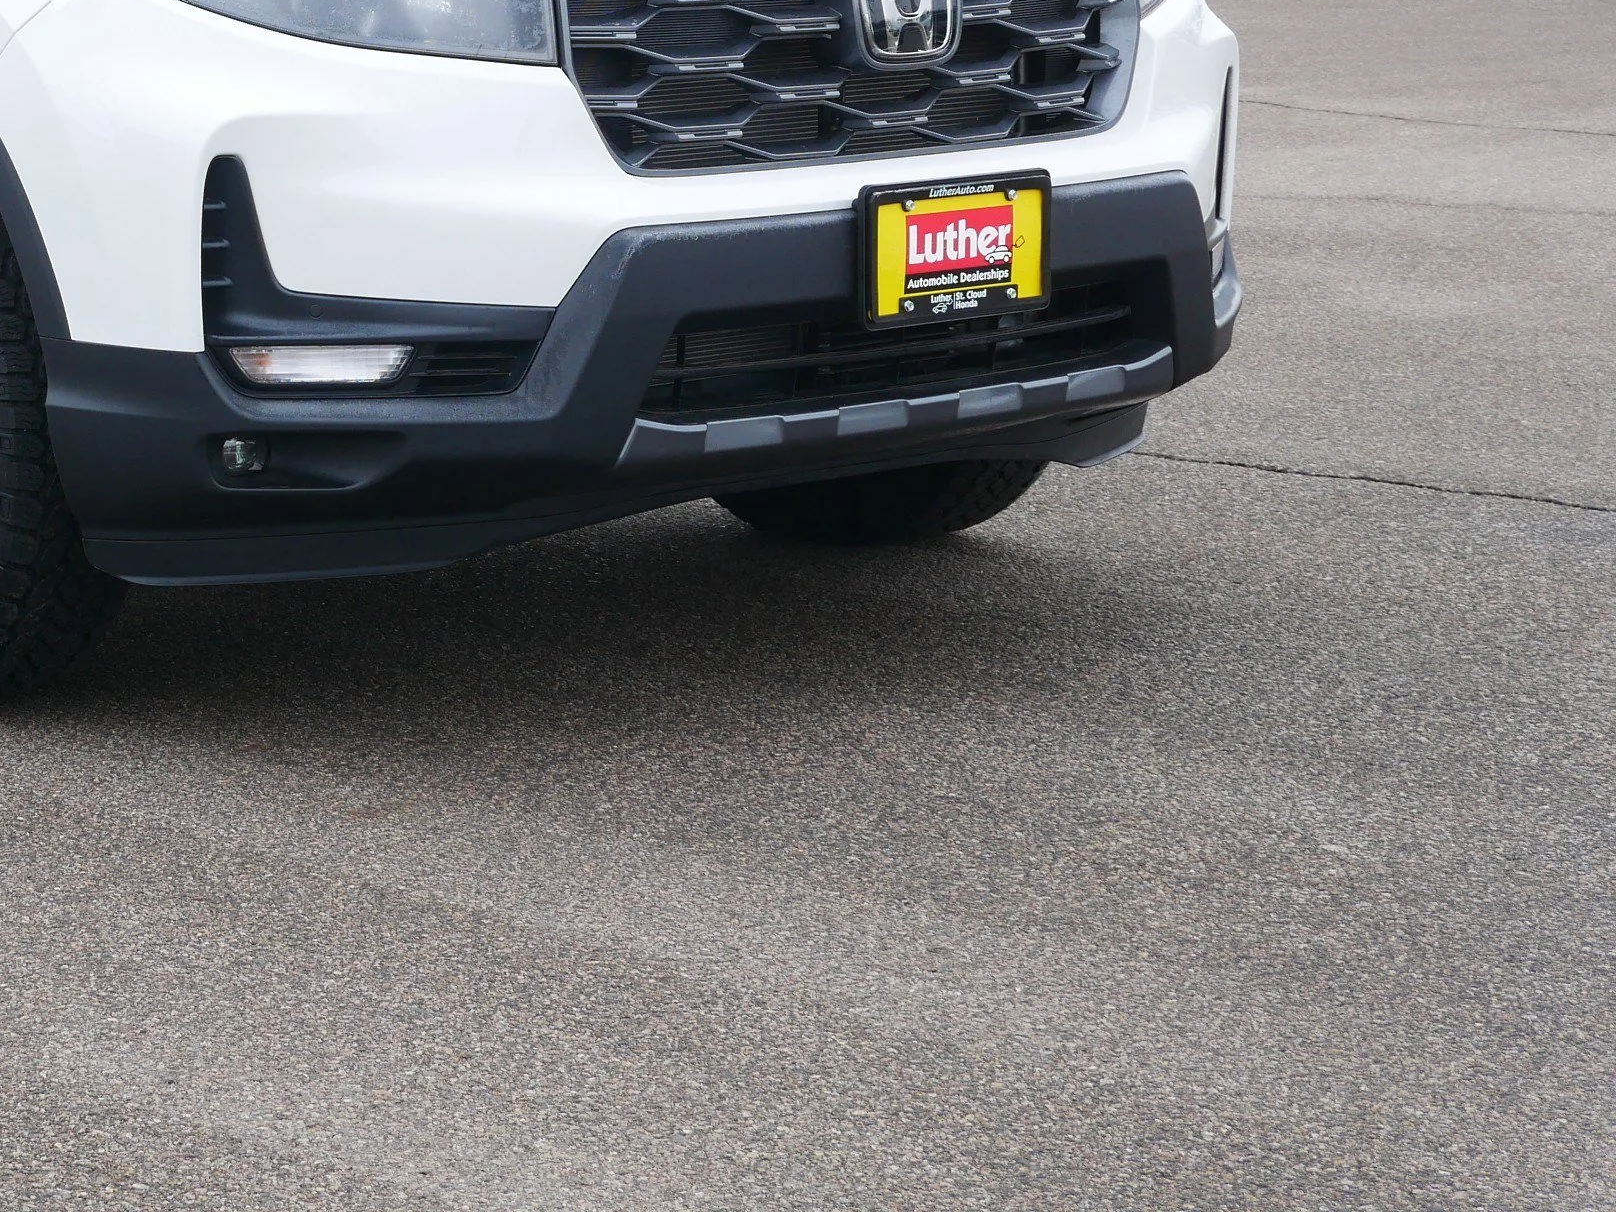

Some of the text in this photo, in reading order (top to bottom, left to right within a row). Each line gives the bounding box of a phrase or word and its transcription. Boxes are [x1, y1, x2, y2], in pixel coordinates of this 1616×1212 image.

[929, 184, 994, 198] LutherAuto.com
[908, 219, 1012, 265] Luther
[907, 268, 1009, 289] Automobile Dealerships
[967, 289, 987, 299] Cloud
[956, 299, 978, 310] Honda
